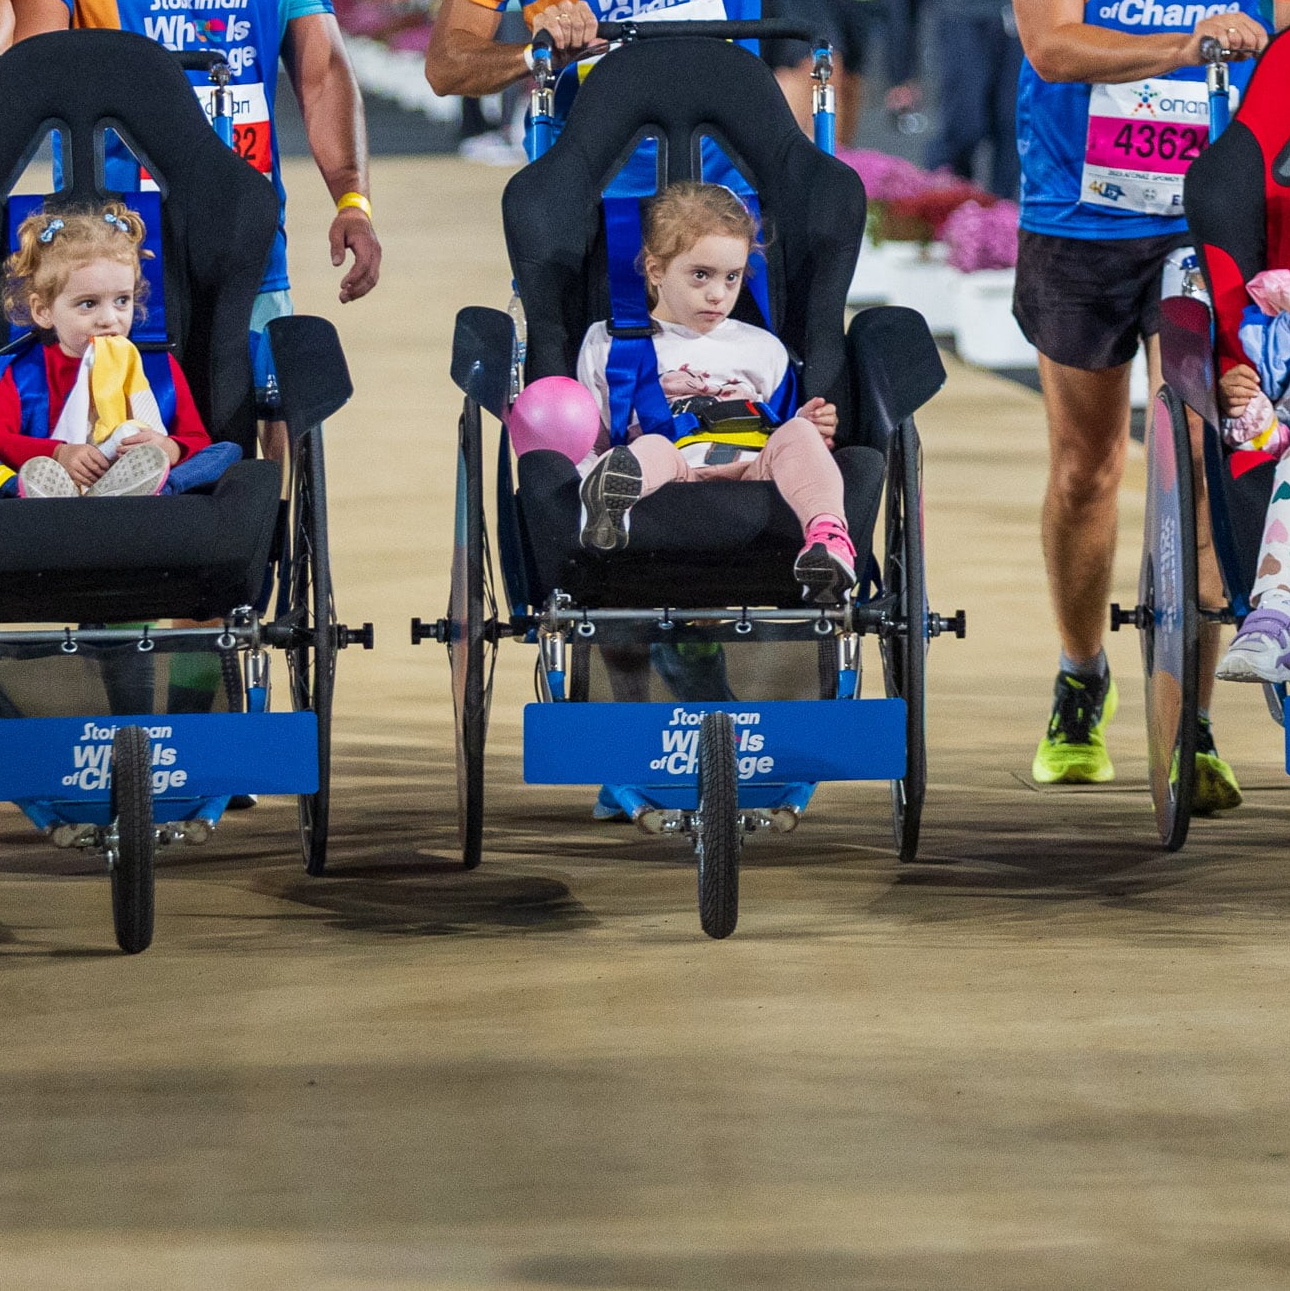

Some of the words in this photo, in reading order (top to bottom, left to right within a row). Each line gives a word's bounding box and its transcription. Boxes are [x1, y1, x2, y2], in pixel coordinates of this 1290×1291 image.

[1099, 2, 1120, 19] of
[143, 14, 251, 43] Wheels
[1114, 123, 1209, 161] 4362
[650, 756, 669, 770] of
[61, 772, 80, 786] of
